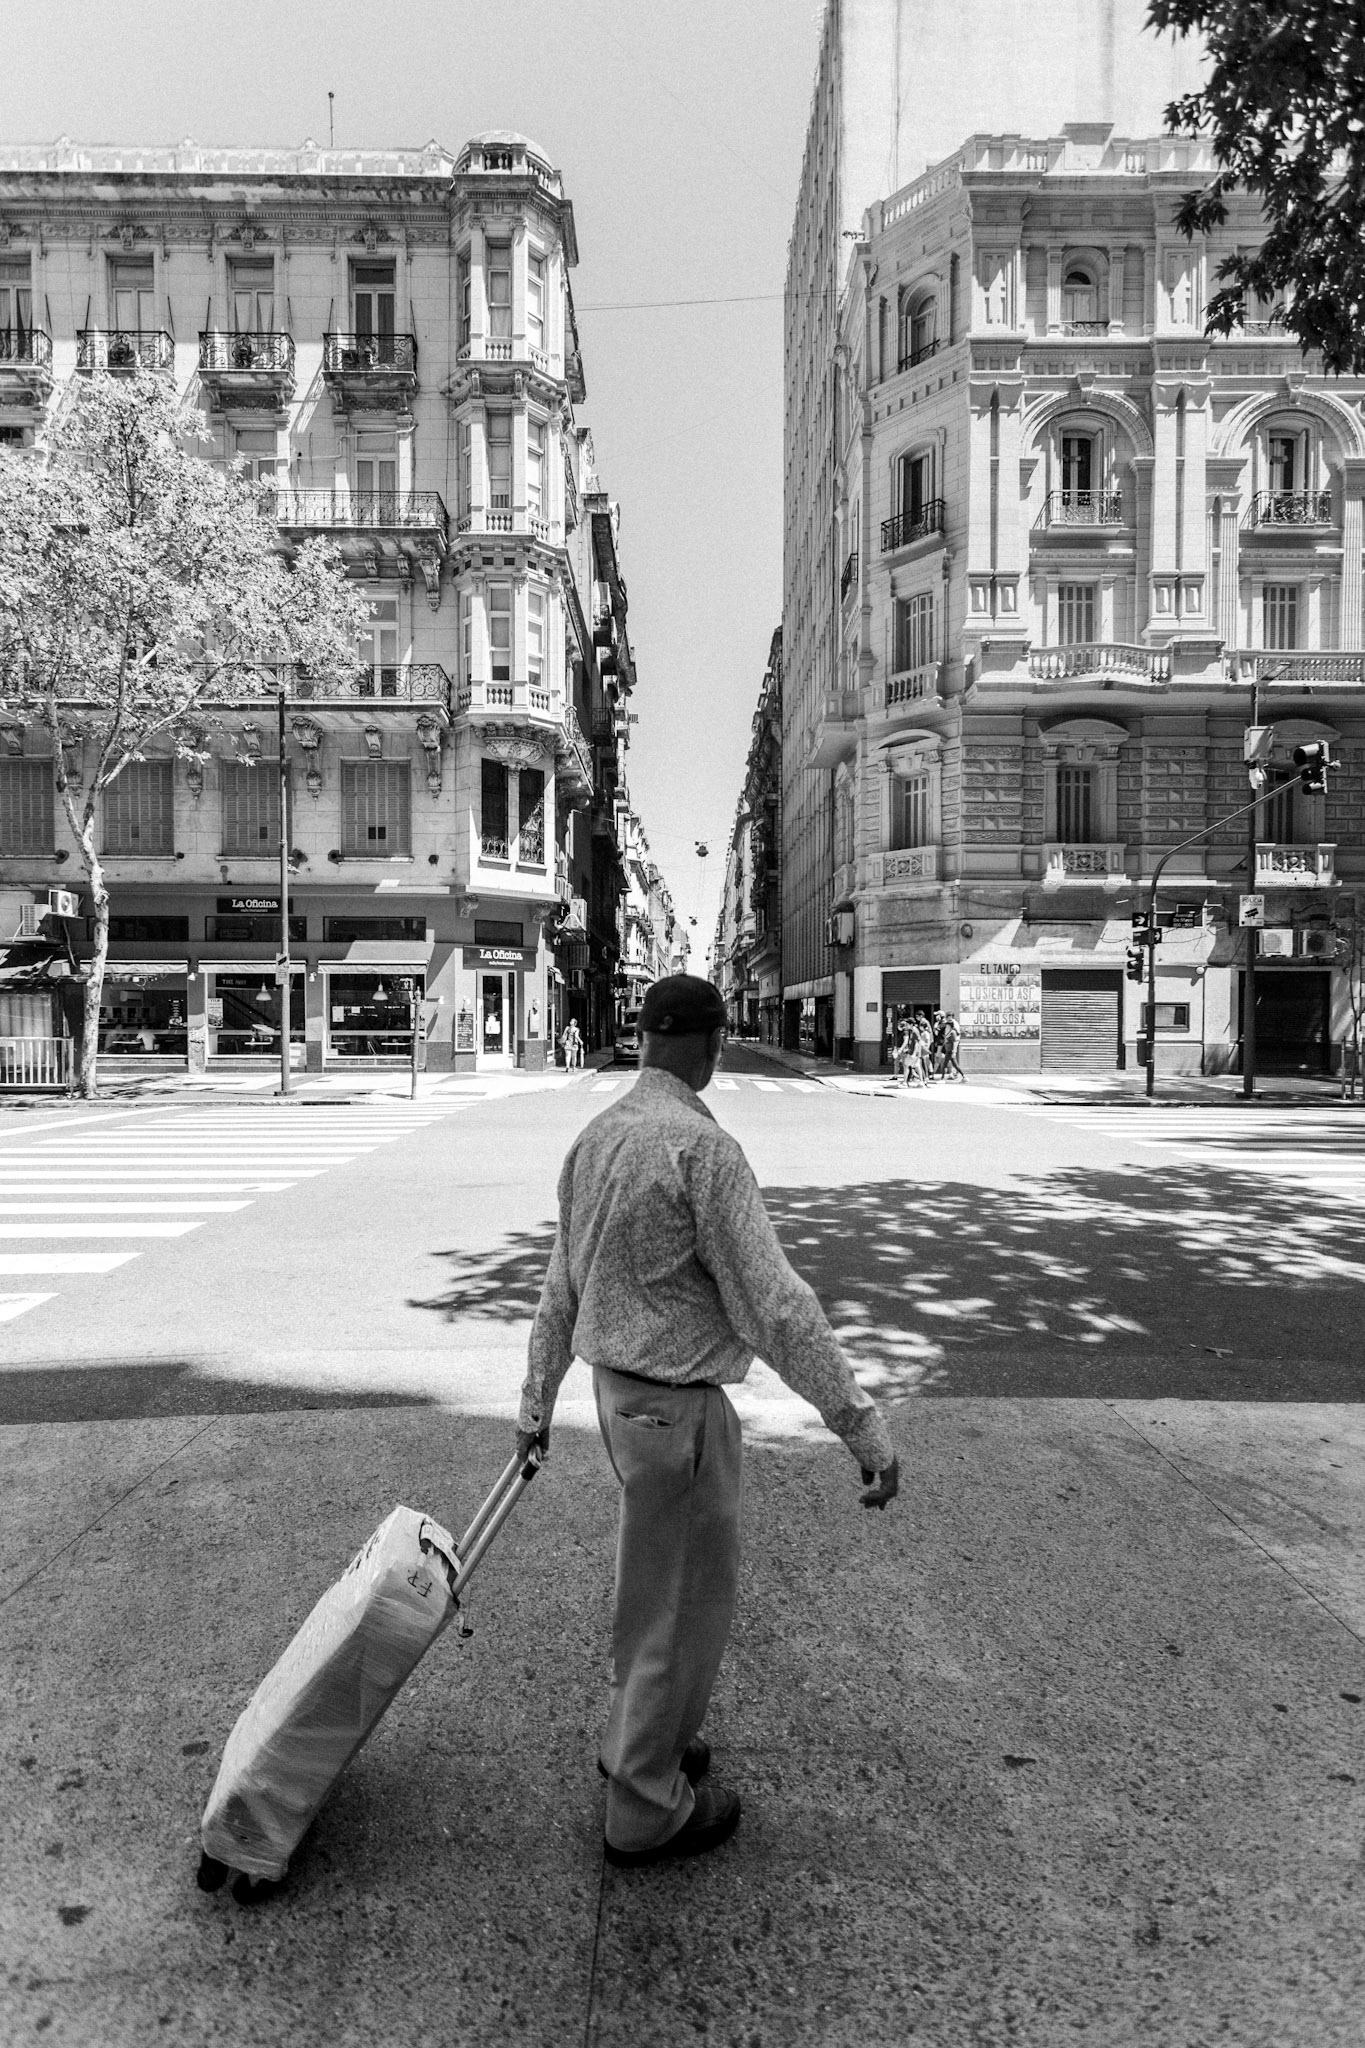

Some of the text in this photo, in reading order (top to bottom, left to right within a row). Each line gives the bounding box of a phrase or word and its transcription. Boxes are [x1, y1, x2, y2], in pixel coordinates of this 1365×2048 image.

[231, 899, 278, 908] La Oficina
[479, 949, 523, 961] La Oficina
[980, 963, 991, 974] EL
[974, 1013, 1026, 1025] JULIO SOSA
